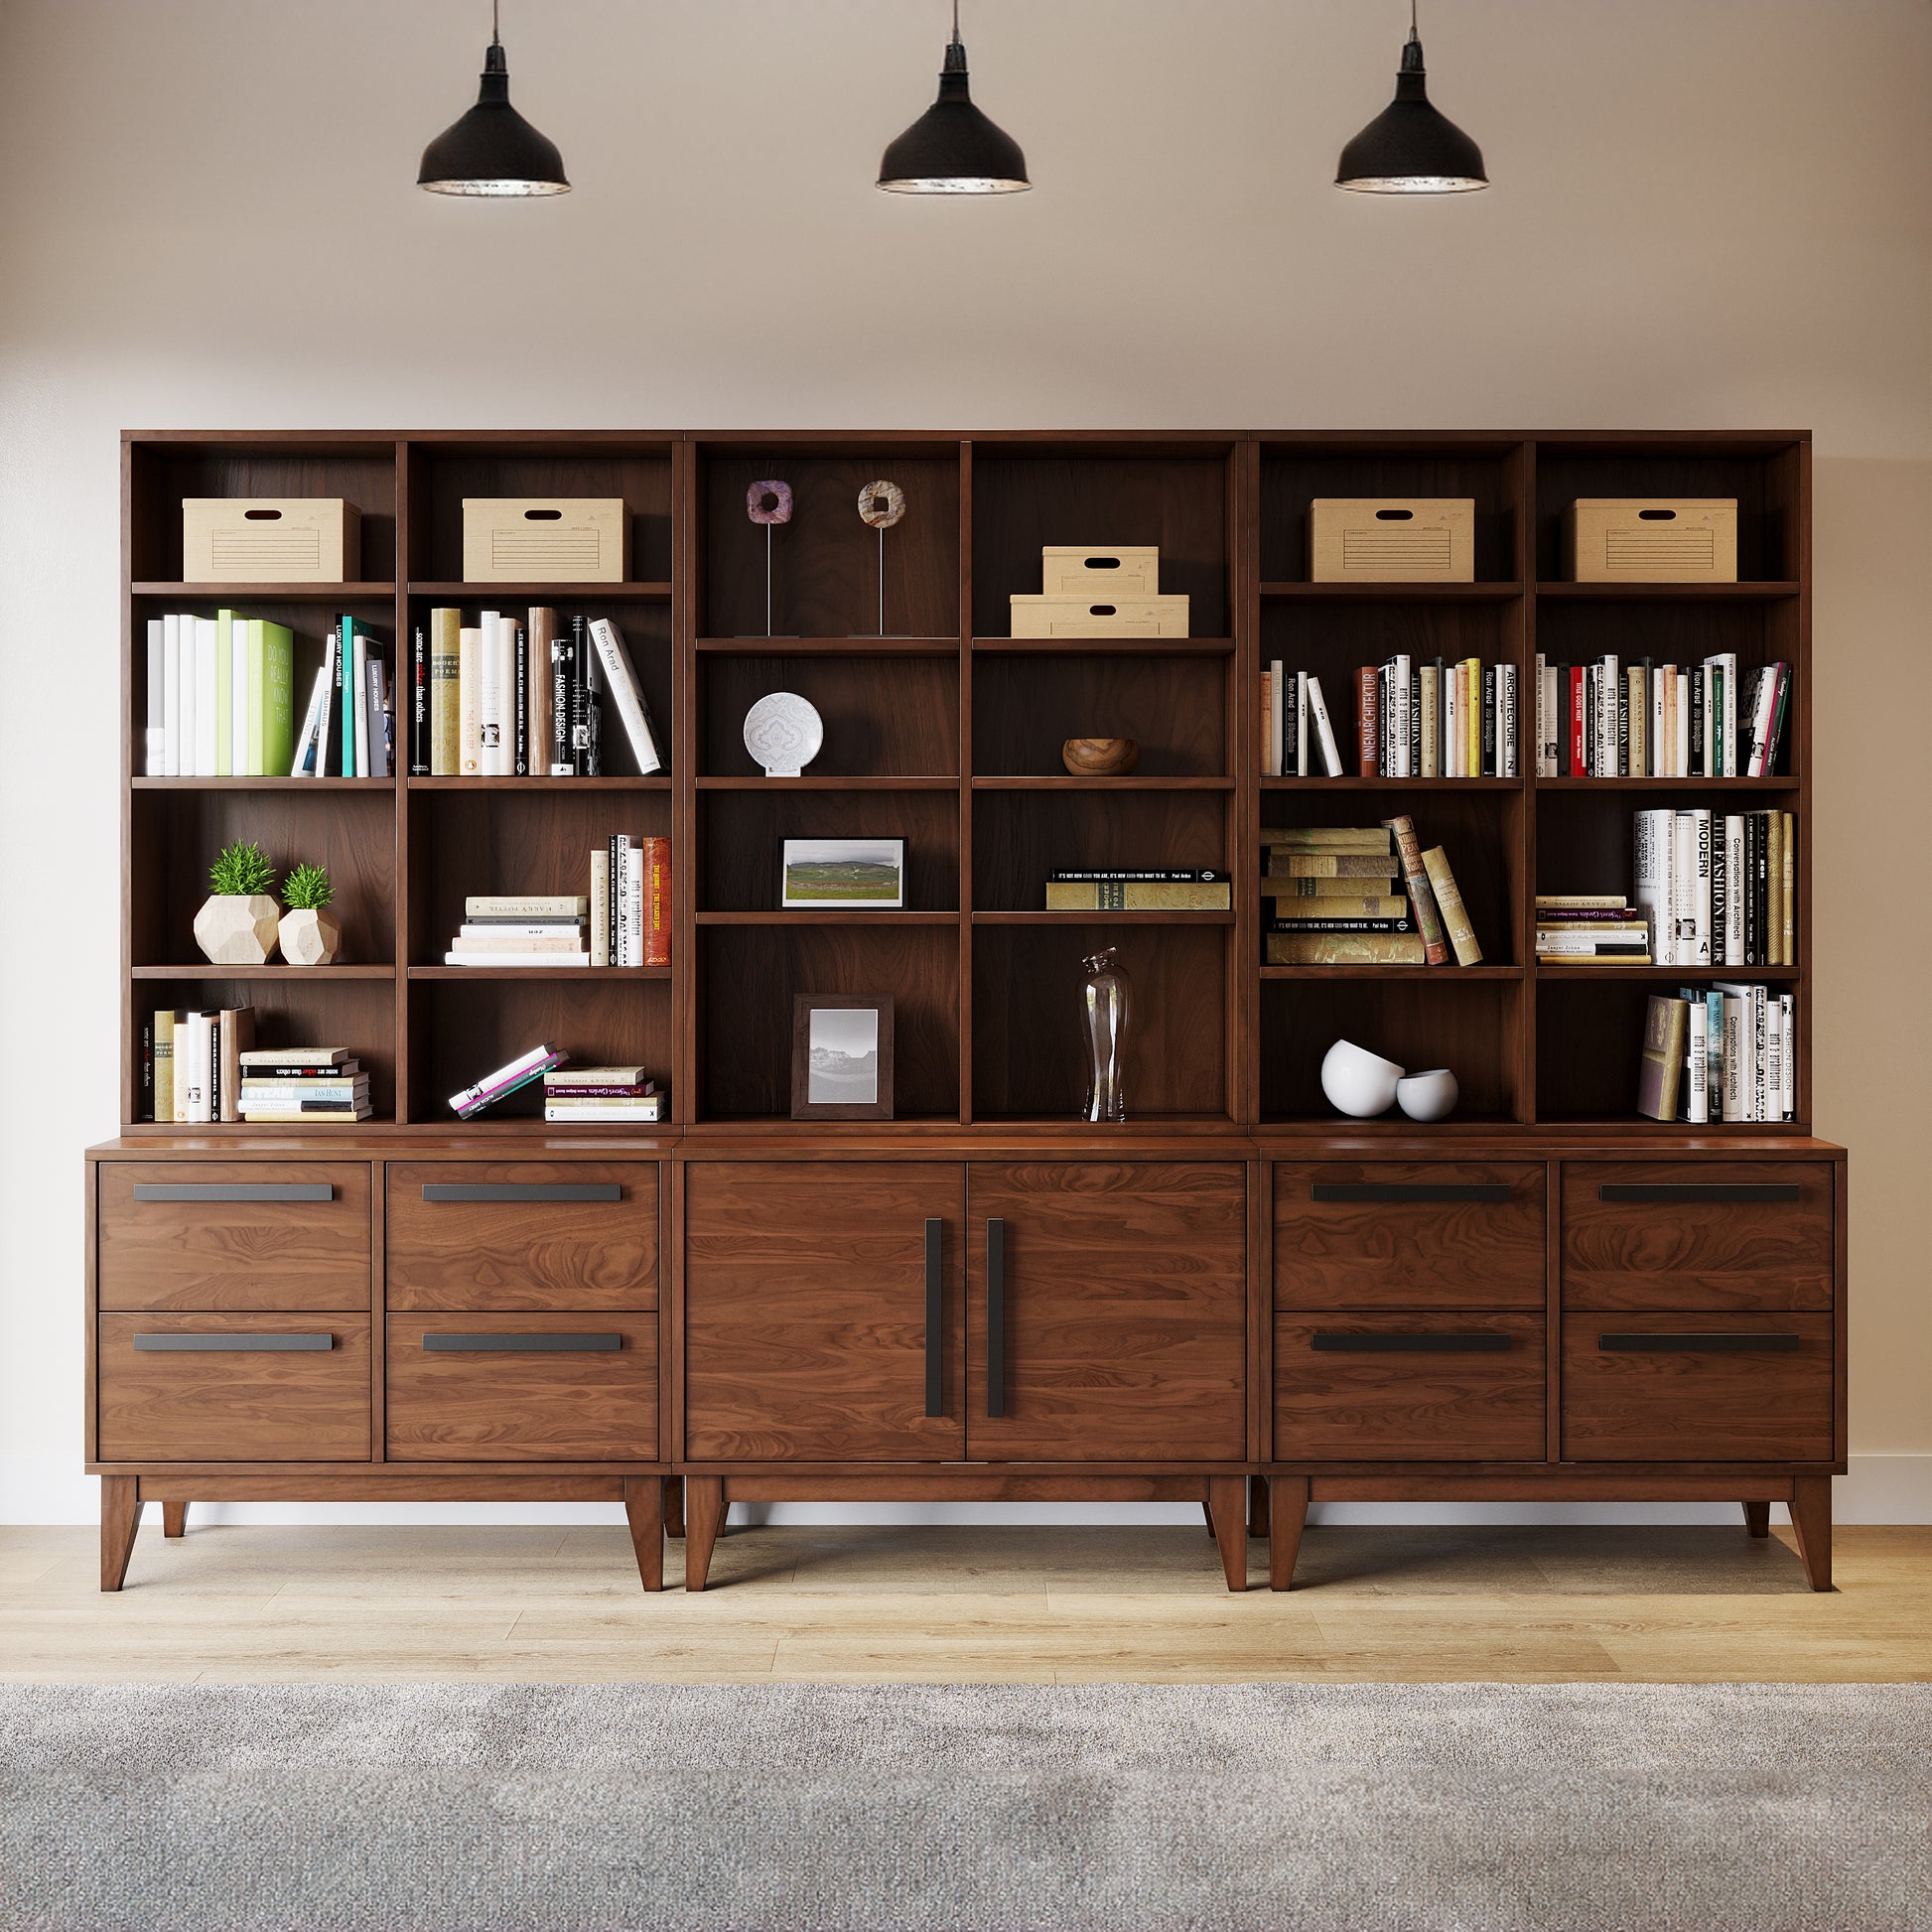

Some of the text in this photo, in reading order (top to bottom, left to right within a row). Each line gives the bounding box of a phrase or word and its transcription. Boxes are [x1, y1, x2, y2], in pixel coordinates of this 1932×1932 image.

[597, 626, 621, 672] Ron Arad
[555, 674, 566, 710] FASHION
[1619, 677, 1628, 697] THE
[555, 712, 566, 743] DESIGN
[1363, 673, 1376, 761] INNENARCHITEKTUR
[1607, 688, 1616, 746] arts architecture
[1619, 699, 1628, 744] FASHION
[1484, 720, 1493, 753] Discipline
[1693, 720, 1702, 753] Discipline
[1507, 760, 1514, 769] Z
[1699, 819, 1709, 878] MODERN
[1714, 816, 1725, 848] THE
[1714, 851, 1725, 915] FASHION
[1700, 941, 1710, 954] A
[1695, 1035, 1706, 1047] arts
[1695, 1056, 1706, 1092] architecture
[1770, 1034, 1780, 1090] arts architecture
